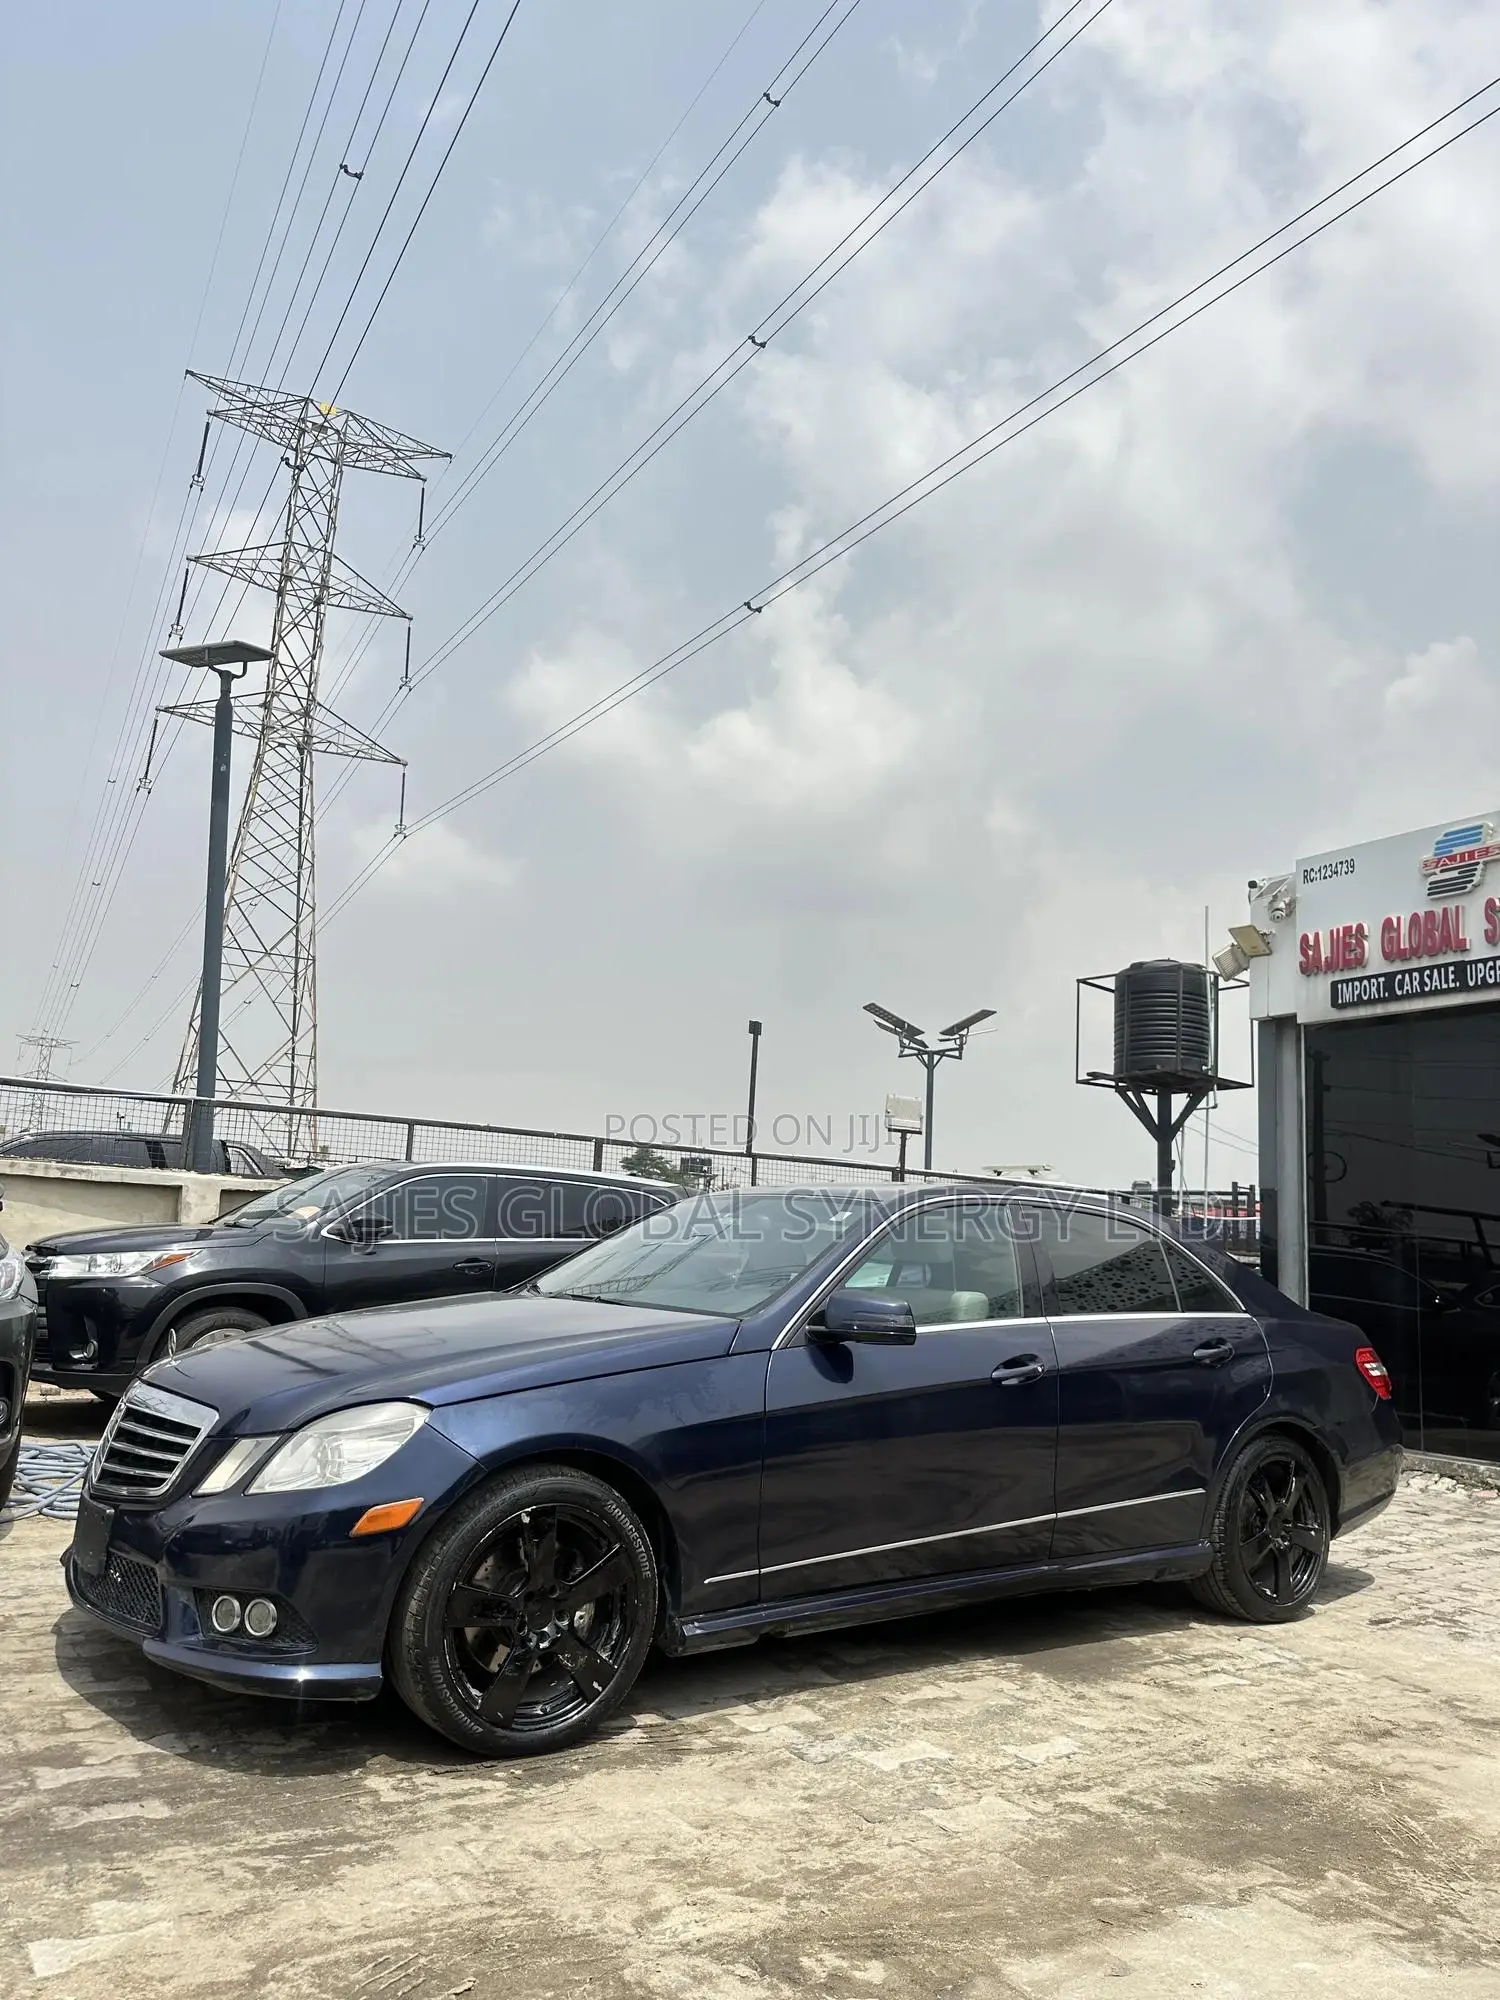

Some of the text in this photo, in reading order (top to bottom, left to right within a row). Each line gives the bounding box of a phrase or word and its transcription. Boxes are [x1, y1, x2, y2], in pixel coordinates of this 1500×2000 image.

[1302, 858, 1356, 884] RC:1234739
[1299, 896, 1500, 976] SAJIES GLOBAL S
[1337, 976, 1389, 1004] IMPORT.
[1394, 971, 1420, 996] CAR
[1423, 965, 1460, 992] SALE.
[604, 1499, 652, 1581] BRIDGESTONE
